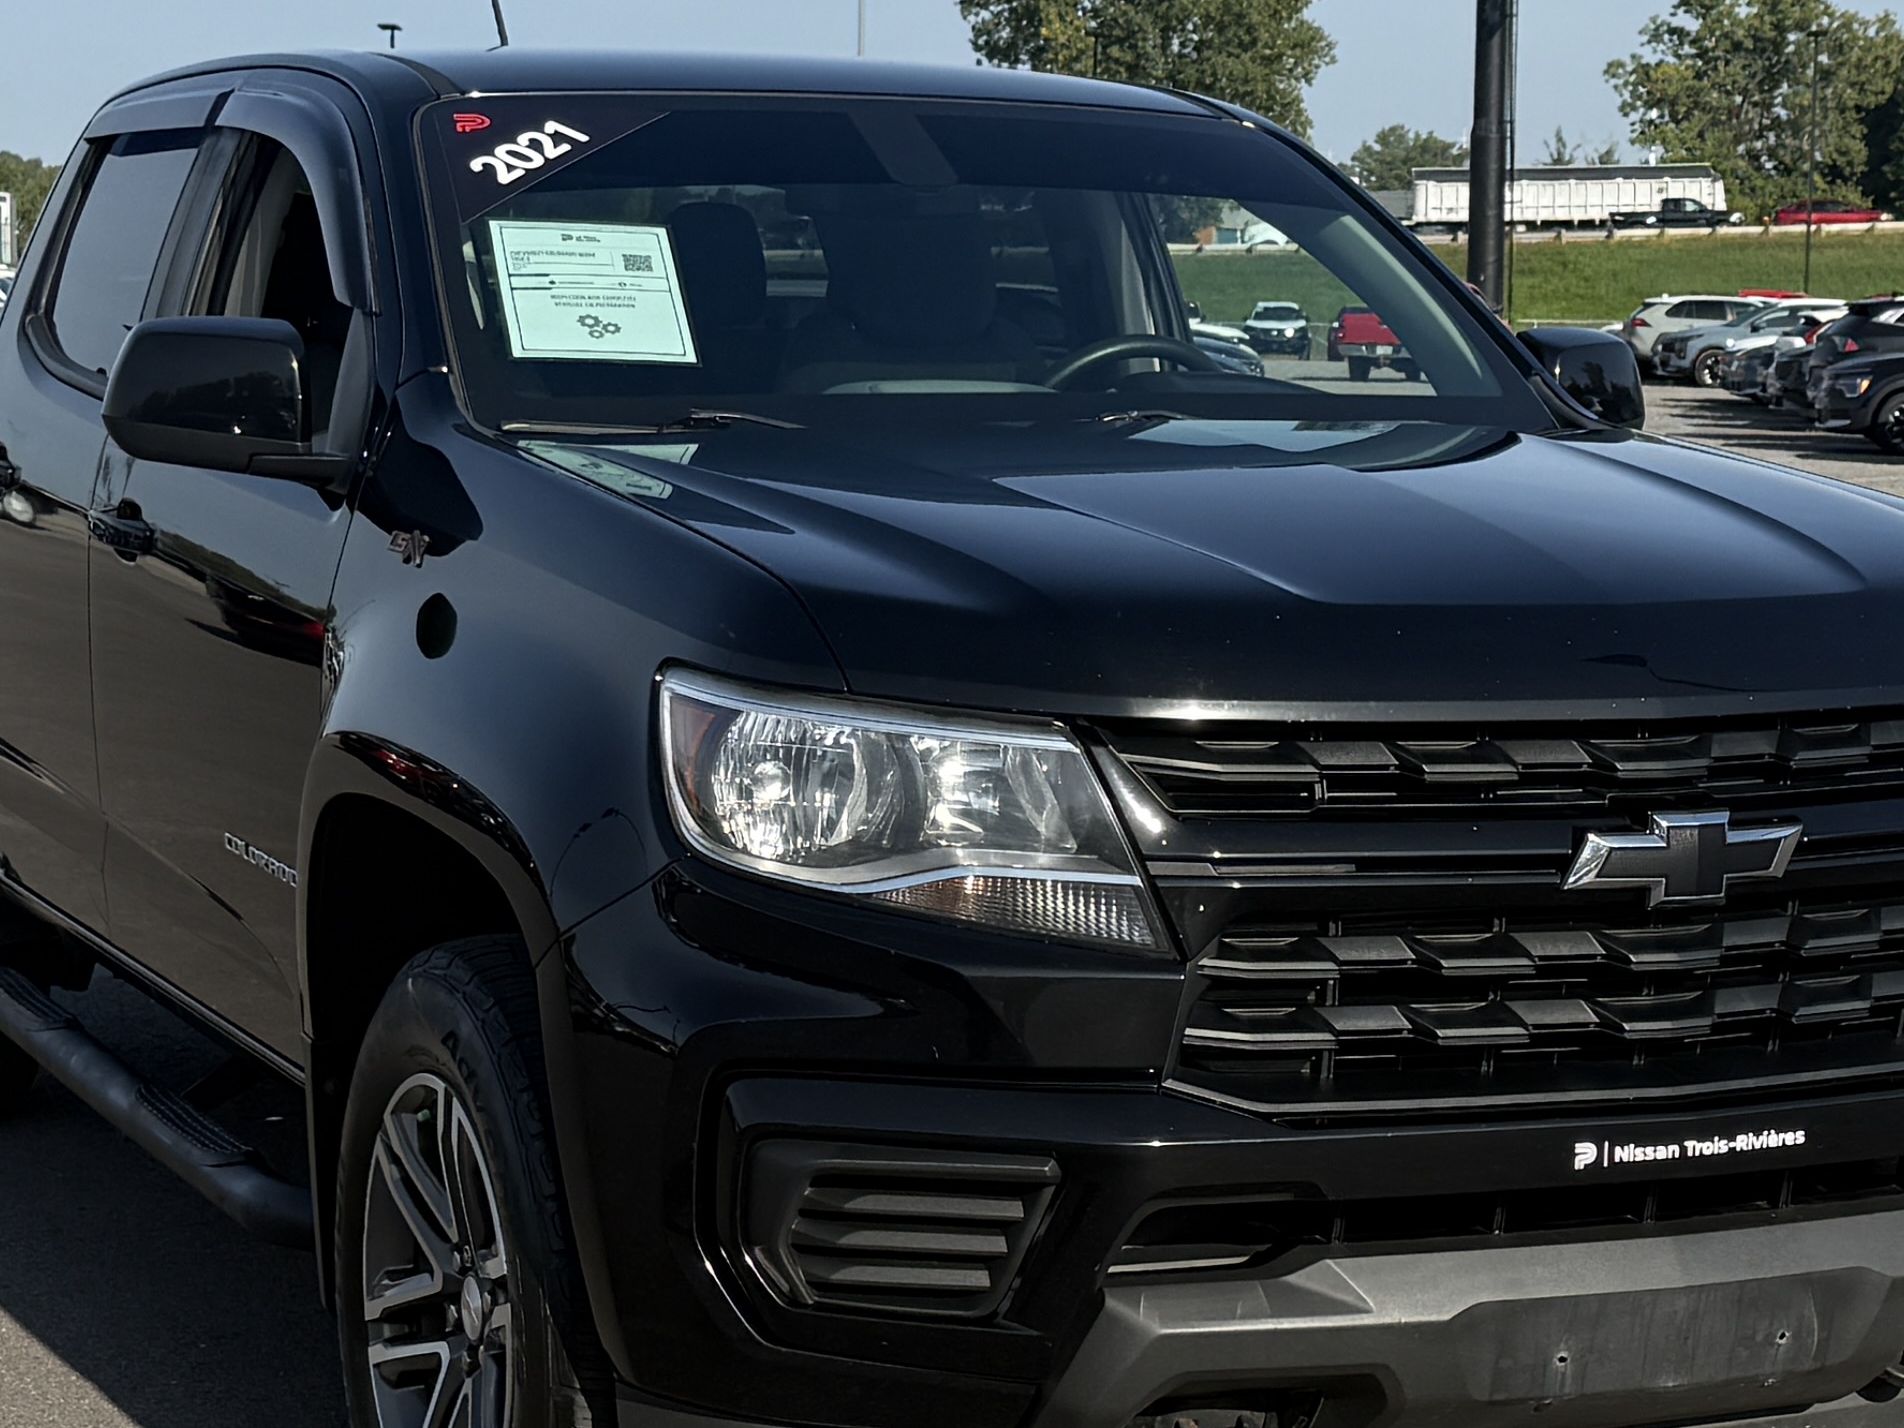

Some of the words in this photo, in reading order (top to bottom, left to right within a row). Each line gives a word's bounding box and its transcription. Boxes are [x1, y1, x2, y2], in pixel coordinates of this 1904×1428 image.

[469, 120, 591, 185] 2021
[1614, 1142, 1680, 1163] Nissan
[1683, 1129, 1806, 1157] Trois-Rivières
